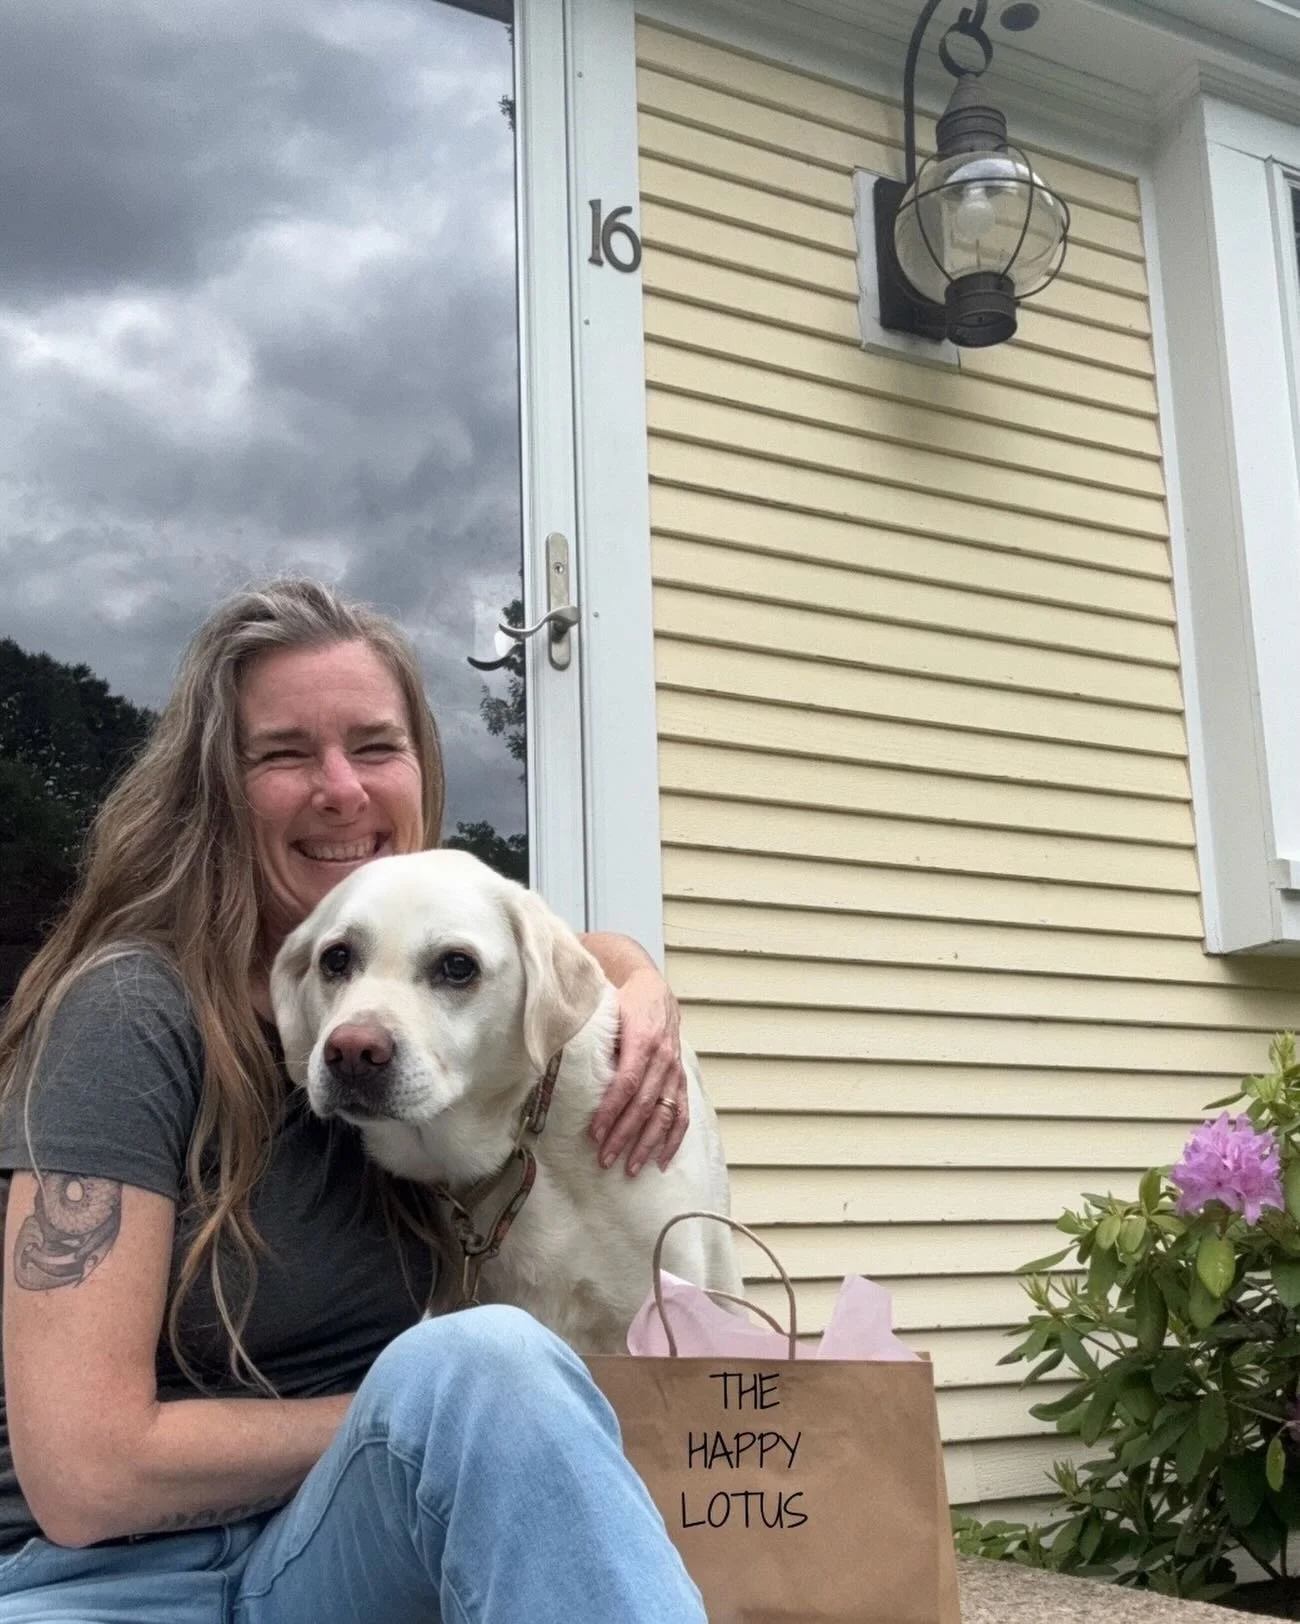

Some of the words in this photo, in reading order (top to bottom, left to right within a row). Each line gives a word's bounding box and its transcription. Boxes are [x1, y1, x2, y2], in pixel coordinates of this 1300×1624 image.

[588, 199, 642, 273] 16
[709, 1371, 780, 1410] THE
[688, 1430, 802, 1470] HAPPY
[681, 1490, 809, 1529] LOTUS
